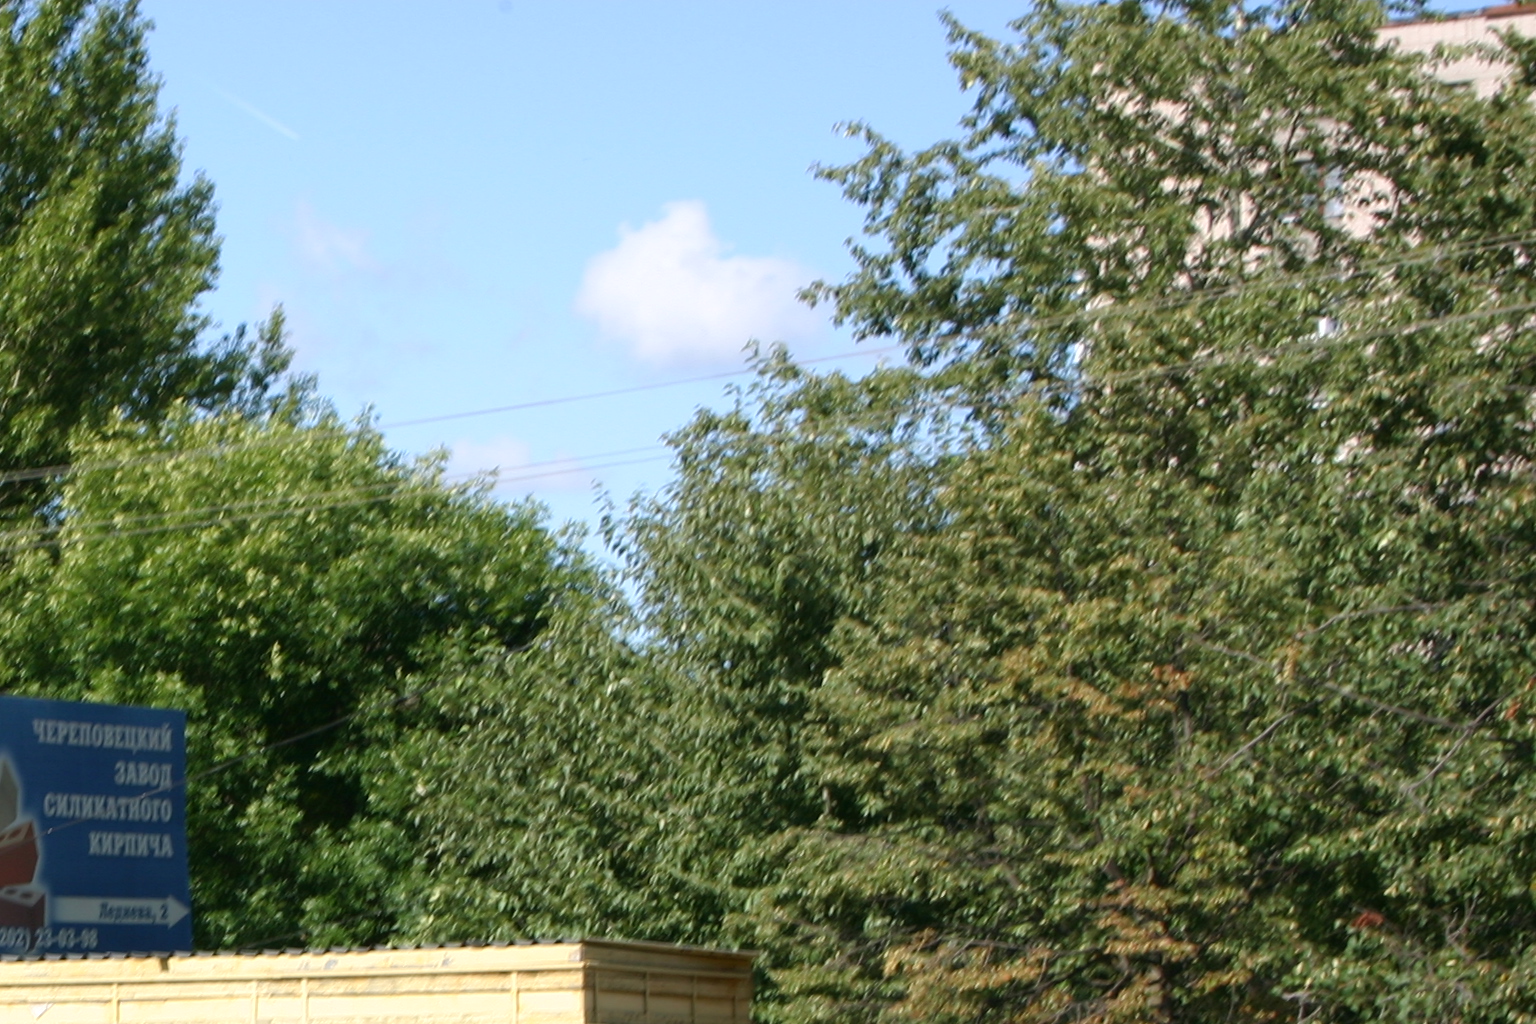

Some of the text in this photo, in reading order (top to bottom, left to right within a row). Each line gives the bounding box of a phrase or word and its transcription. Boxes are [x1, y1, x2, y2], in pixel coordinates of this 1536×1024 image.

[32, 718, 172, 754] ЧЕРЕПОВЕЦКИЙ
[114, 761, 172, 789] ЗАВОД
[43, 792, 172, 822] СИЛИКАТНОГО
[88, 831, 173, 858] КИРПИЧА
